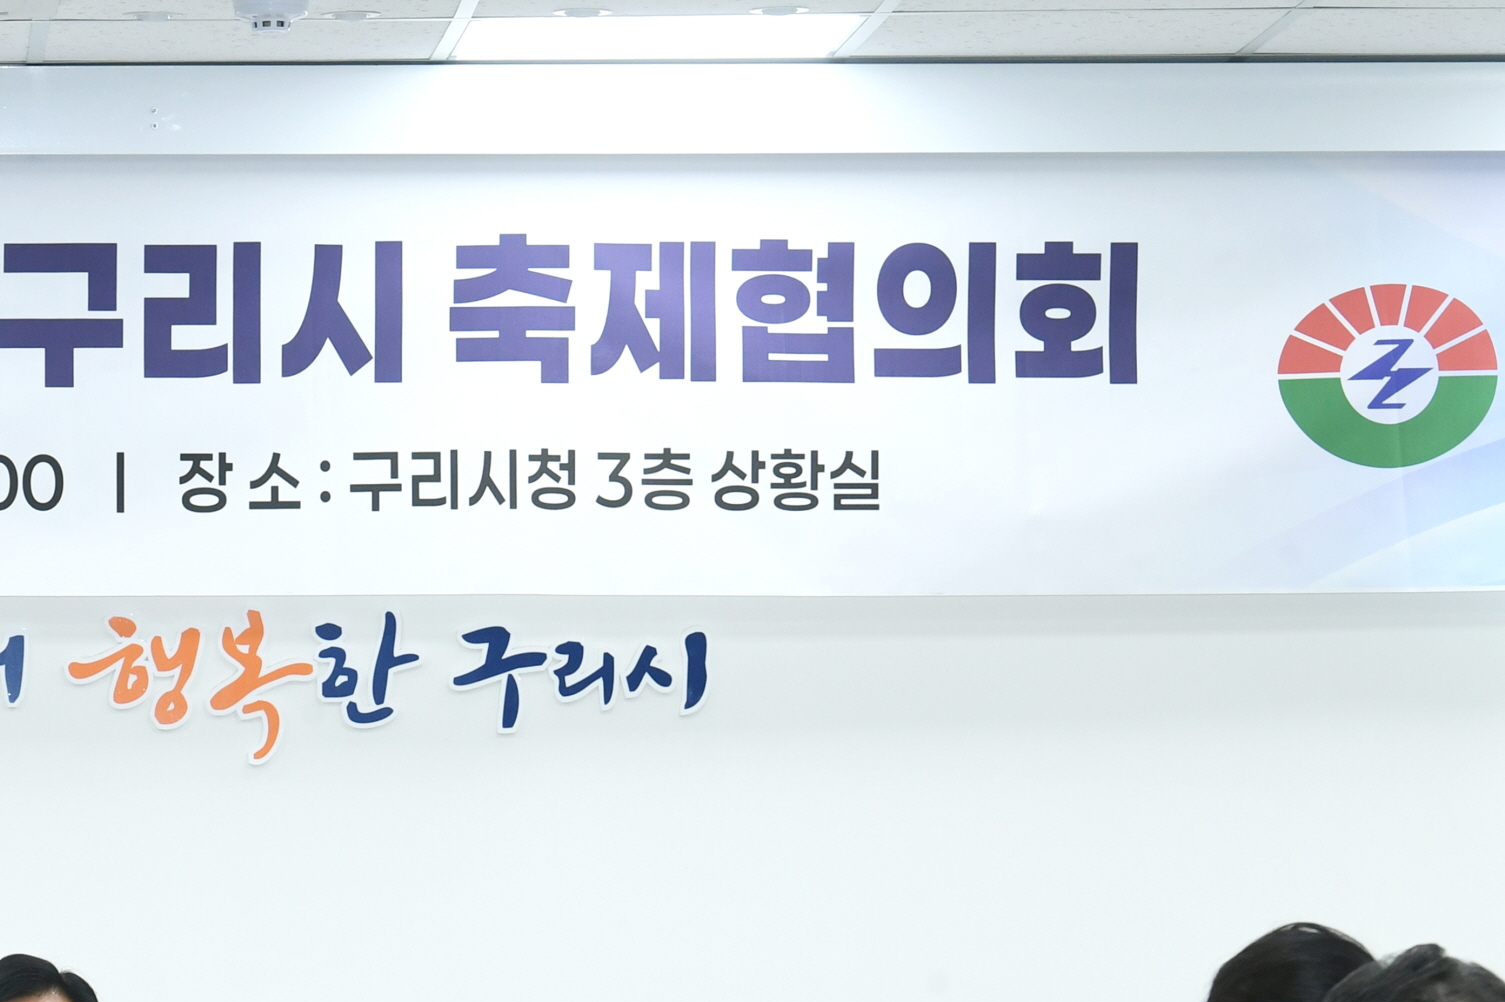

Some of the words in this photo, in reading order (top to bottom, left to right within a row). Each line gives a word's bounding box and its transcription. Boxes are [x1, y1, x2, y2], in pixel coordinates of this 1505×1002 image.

[450, 234, 1138, 384] 축제협의회
[349, 449, 576, 512] 구리시청
[596, 447, 693, 511] 3층
[711, 448, 880, 512] 상황실
[68, 609, 420, 760] 행복한
[452, 625, 708, 732] 구리시
